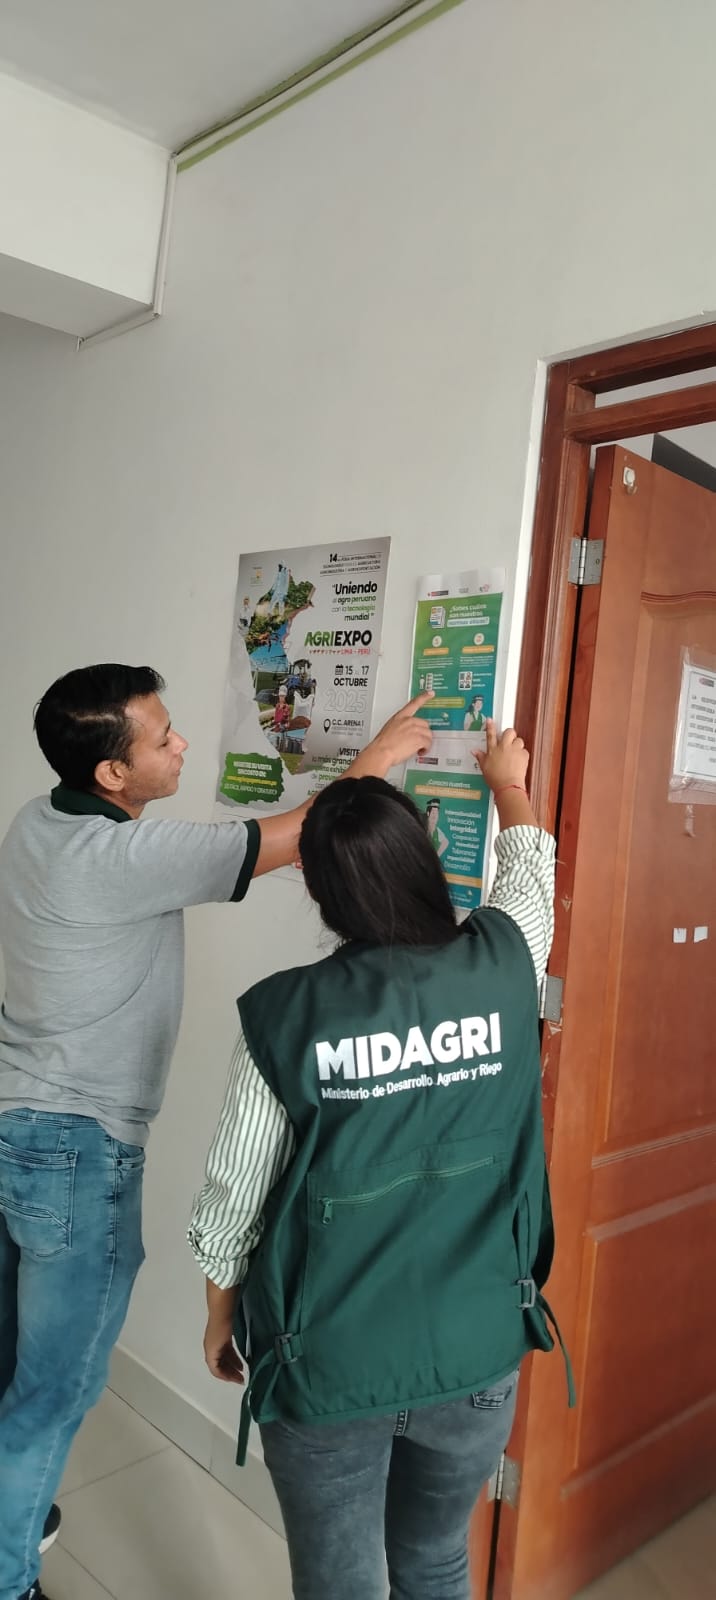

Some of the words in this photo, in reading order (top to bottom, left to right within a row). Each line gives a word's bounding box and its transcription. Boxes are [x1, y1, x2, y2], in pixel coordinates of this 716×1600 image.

[329, 553, 338, 562] 14
[337, 597, 351, 605] agro
[351, 595, 376, 604] peruano
[304, 630, 372, 646] AGRIEXPO
[345, 665, 353, 675] 15
[361, 665, 369, 675] 17
[333, 678, 368, 687] OCTUBRE
[323, 688, 368, 713] 2025
[447, 817, 475, 826] Innovación
[450, 824, 477, 834] Integridad
[315, 1012, 502, 1081] MIDAGRI
[321, 1087, 369, 1100] Ministerio
[372, 1084, 385, 1097] de
[386, 1074, 433, 1095] Desarrollo
[437, 1068, 469, 1087] Agrario
[470, 1067, 478, 1081] y
[479, 1061, 502, 1077] Riego
